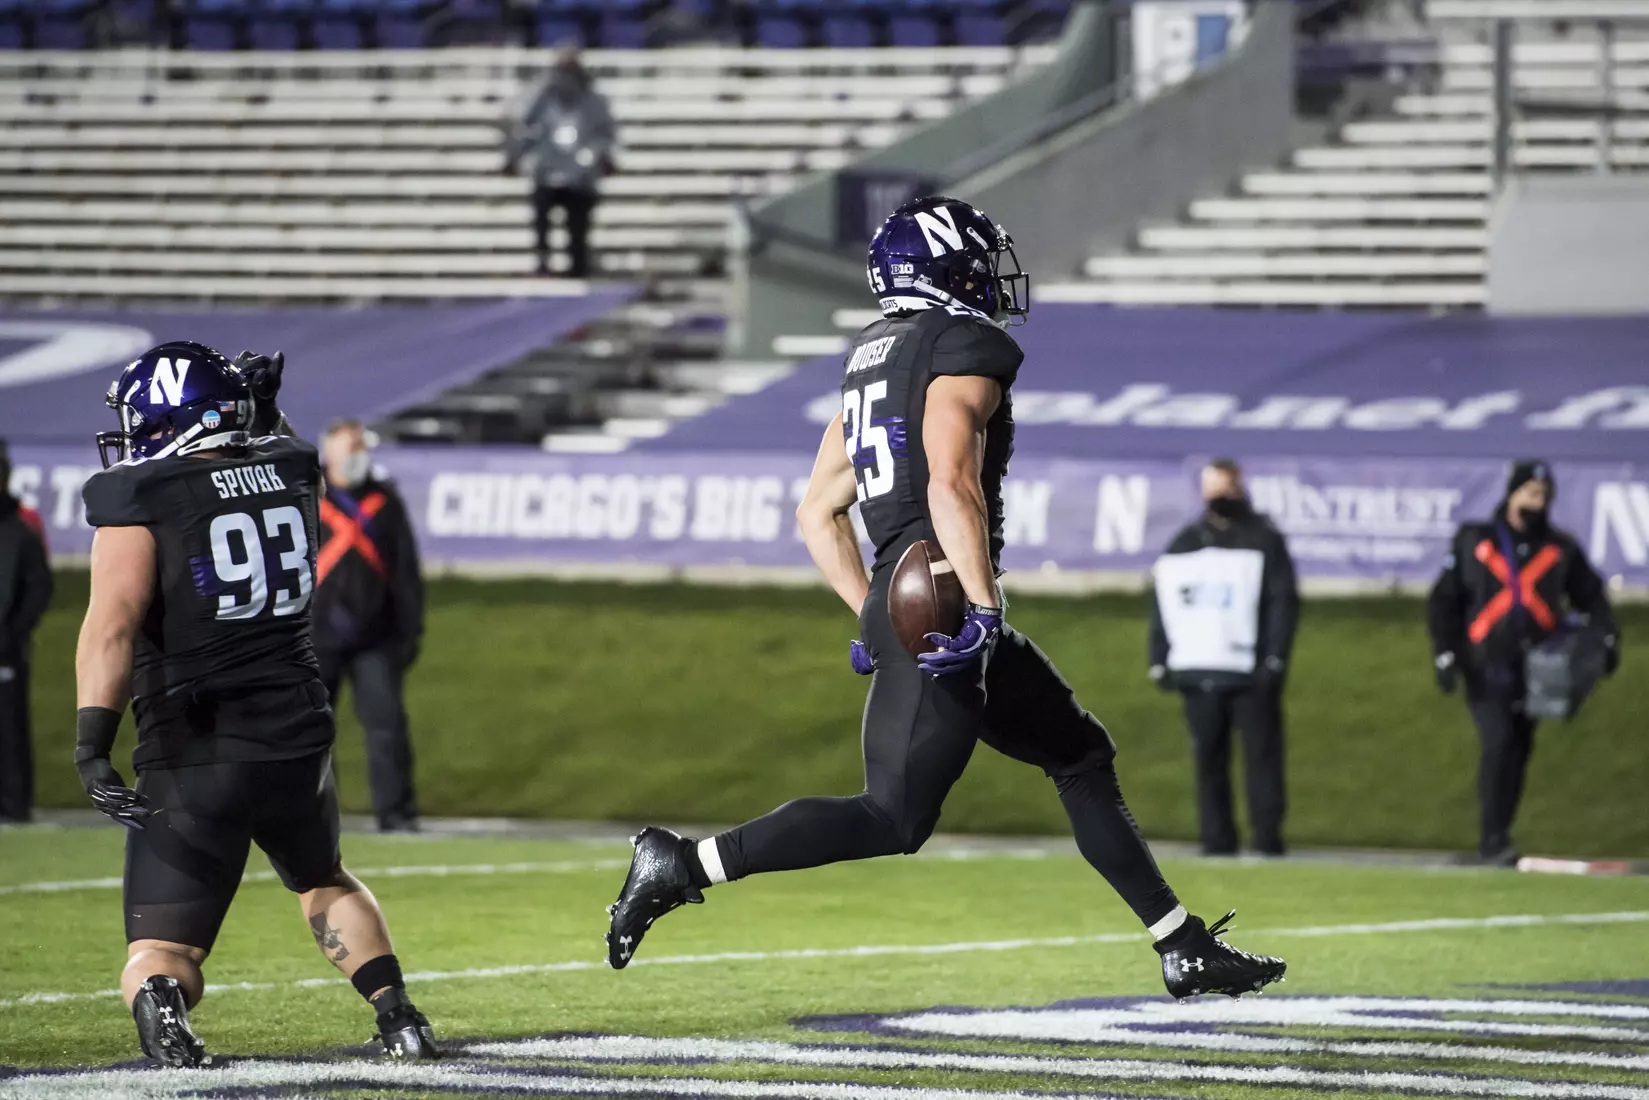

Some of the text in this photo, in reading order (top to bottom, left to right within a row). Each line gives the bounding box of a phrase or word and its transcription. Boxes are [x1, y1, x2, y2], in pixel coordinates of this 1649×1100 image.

[914, 206, 964, 258] N
[149, 357, 191, 406] N
[843, 380, 894, 501] 25
[210, 463, 287, 499] SPIVAK
[426, 473, 687, 541] CHICAGO'S
[690, 475, 784, 543] BIG
[1092, 474, 1150, 556] N
[209, 505, 312, 621] 93
